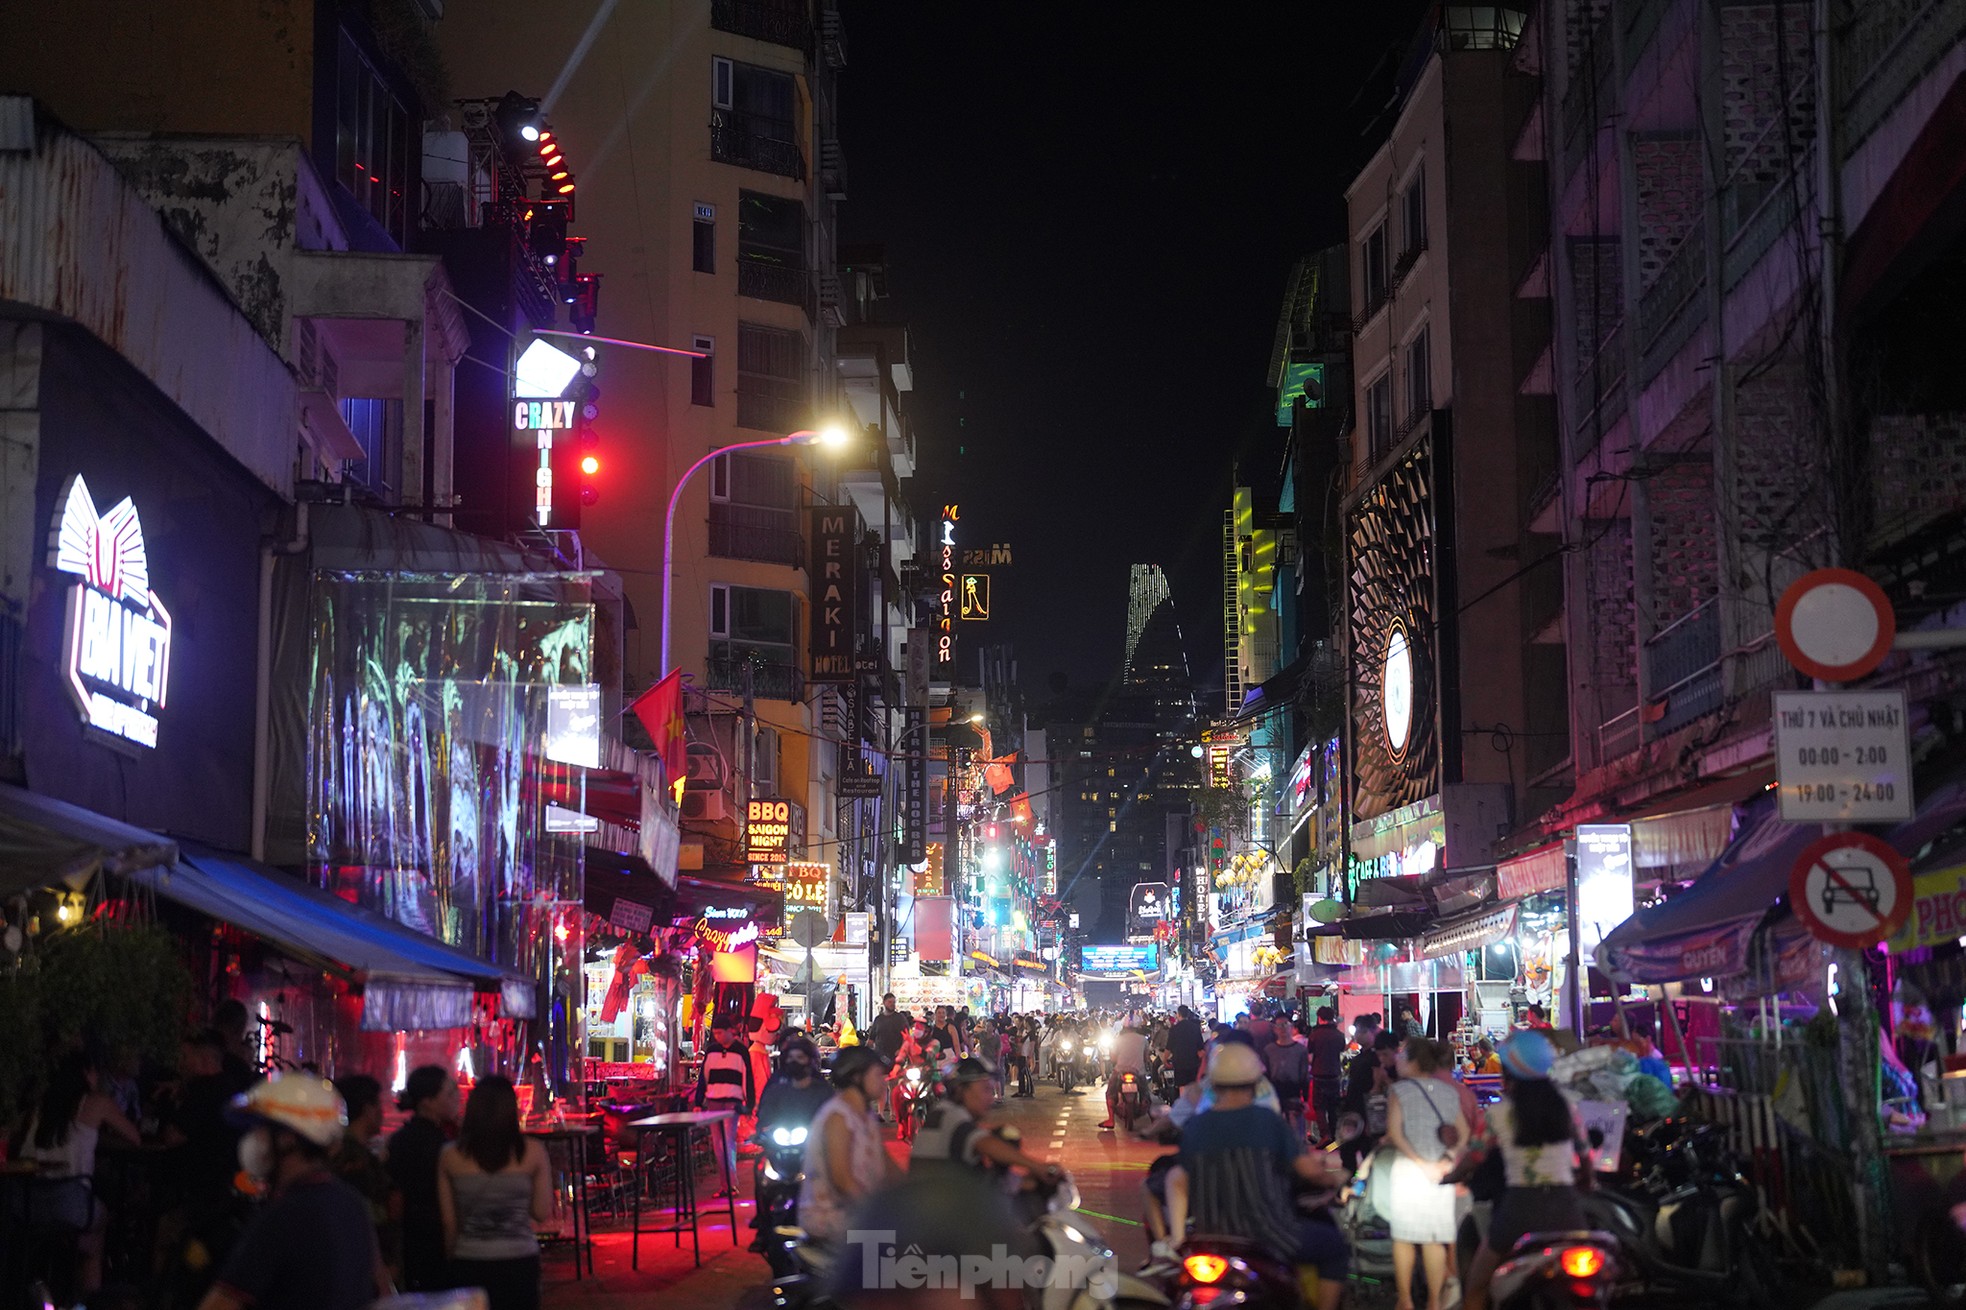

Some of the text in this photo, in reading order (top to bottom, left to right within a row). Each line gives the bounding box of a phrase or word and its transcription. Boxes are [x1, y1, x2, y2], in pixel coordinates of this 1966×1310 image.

[515, 401, 575, 429] CRAZY
[536, 430, 552, 525] NIGHT
[821, 516, 844, 648] MERAKI
[814, 655, 851, 674] HOTEL
[1781, 706, 1804, 728] THỨ
[1808, 710, 1815, 728] 7
[1819, 706, 1837, 728] VÀ
[1867, 704, 1899, 729] NHẬT
[1798, 747, 1839, 765] 00:00
[1855, 746, 1887, 763] 2:00
[911, 771, 920, 797] THE
[1797, 784, 1835, 801] 19:00
[1852, 783, 1894, 801] 24:00
[748, 801, 789, 822] BBQ
[748, 824, 788, 835] SAIGON
[751, 836, 785, 847] NIGHT
[747, 852, 769, 862] SINCE
[1196, 876, 1206, 921] HOTEL
